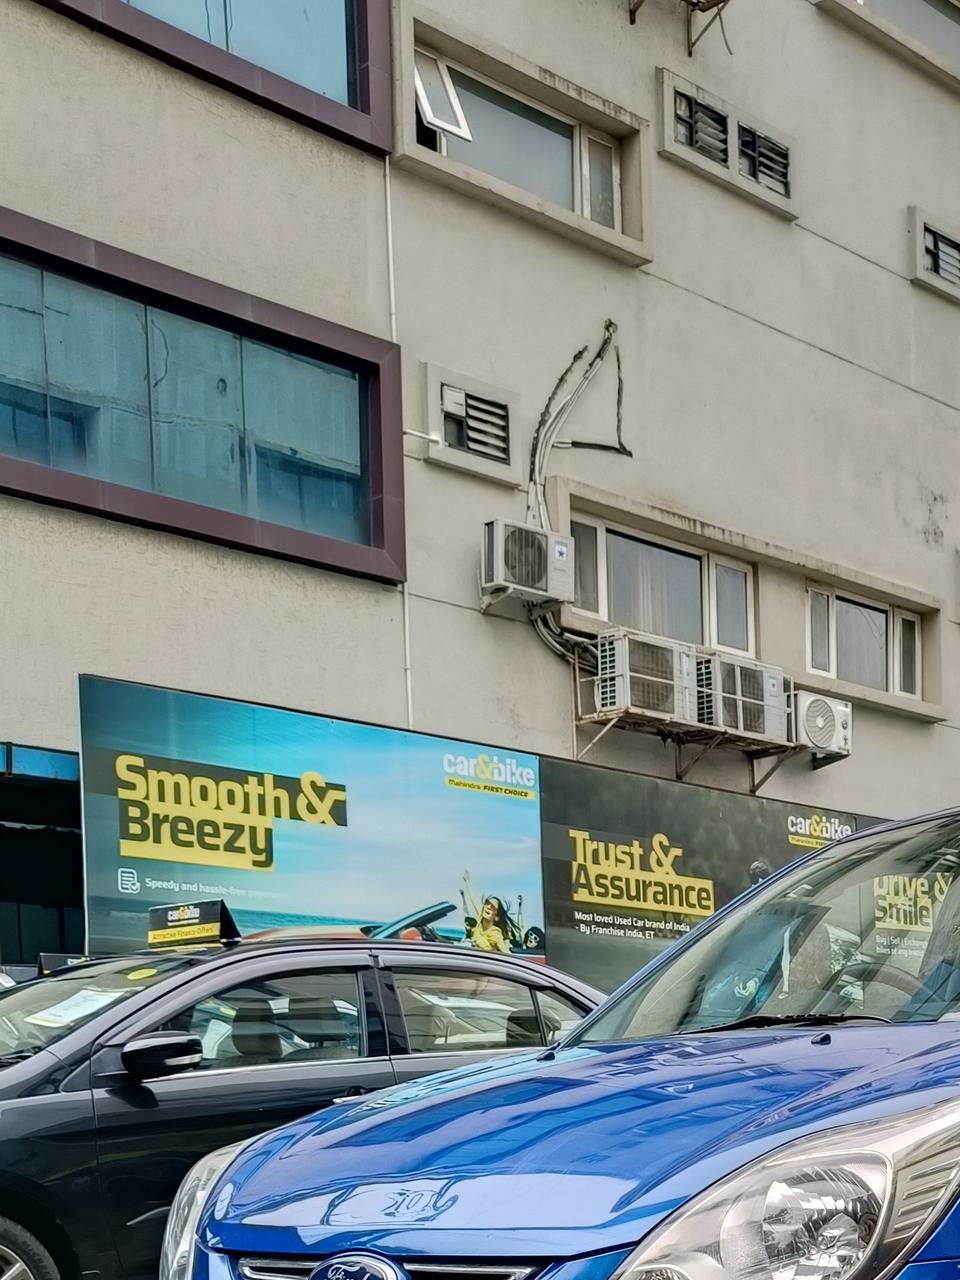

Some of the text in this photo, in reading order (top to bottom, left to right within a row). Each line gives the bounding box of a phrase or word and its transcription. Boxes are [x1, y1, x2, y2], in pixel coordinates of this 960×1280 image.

[443, 753, 535, 787] car&bike
[115, 754, 346, 826] Smooth &
[483, 785, 503, 794] FIRST
[504, 788, 529, 798] CHOICE
[118, 798, 274, 868] Breezy
[787, 814, 852, 841] car&bike
[569, 829, 683, 876] Trust &
[145, 878, 180, 892] Speedy
[180, 882, 198, 892] and
[572, 862, 712, 911] Assurance
[574, 911, 690, 932] Most loved Used Car brand of India
[874, 894, 931, 927] Smile
[580, 923, 591, 935] By
[591, 925, 625, 937] Franchise
[625, 929, 645, 940] India,
[645, 931, 655, 940] ET
